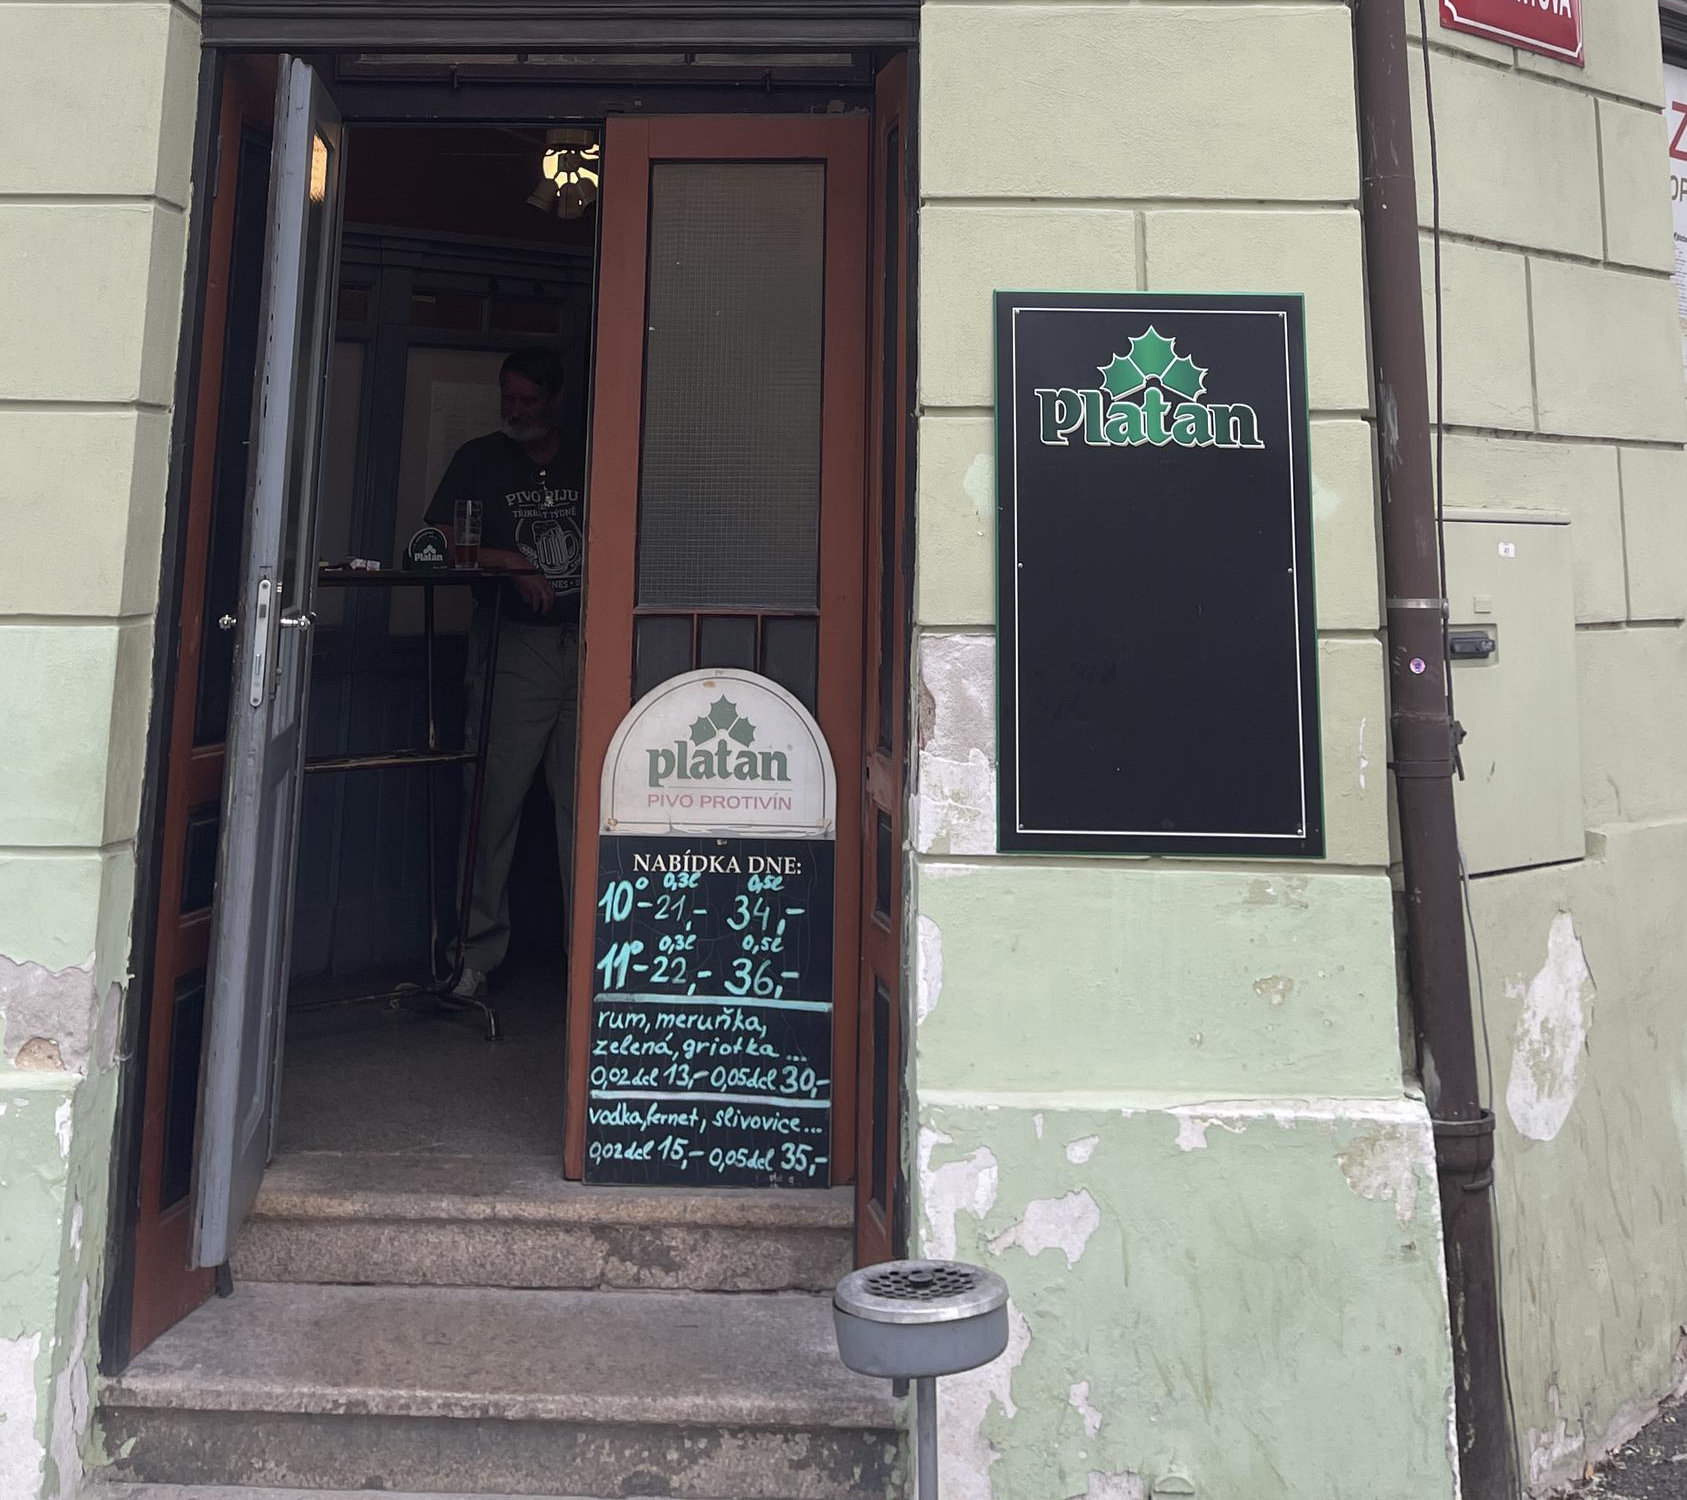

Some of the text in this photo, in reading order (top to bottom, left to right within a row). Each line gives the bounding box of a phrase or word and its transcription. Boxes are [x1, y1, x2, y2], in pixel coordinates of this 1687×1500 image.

[505, 490, 541, 506] PIVO
[646, 739, 791, 788] platan
[647, 792, 792, 811] PIVO PROTIVÍN
[633, 849, 802, 875] NABÍDKA DNE:
[597, 1012, 651, 1035] rum,
